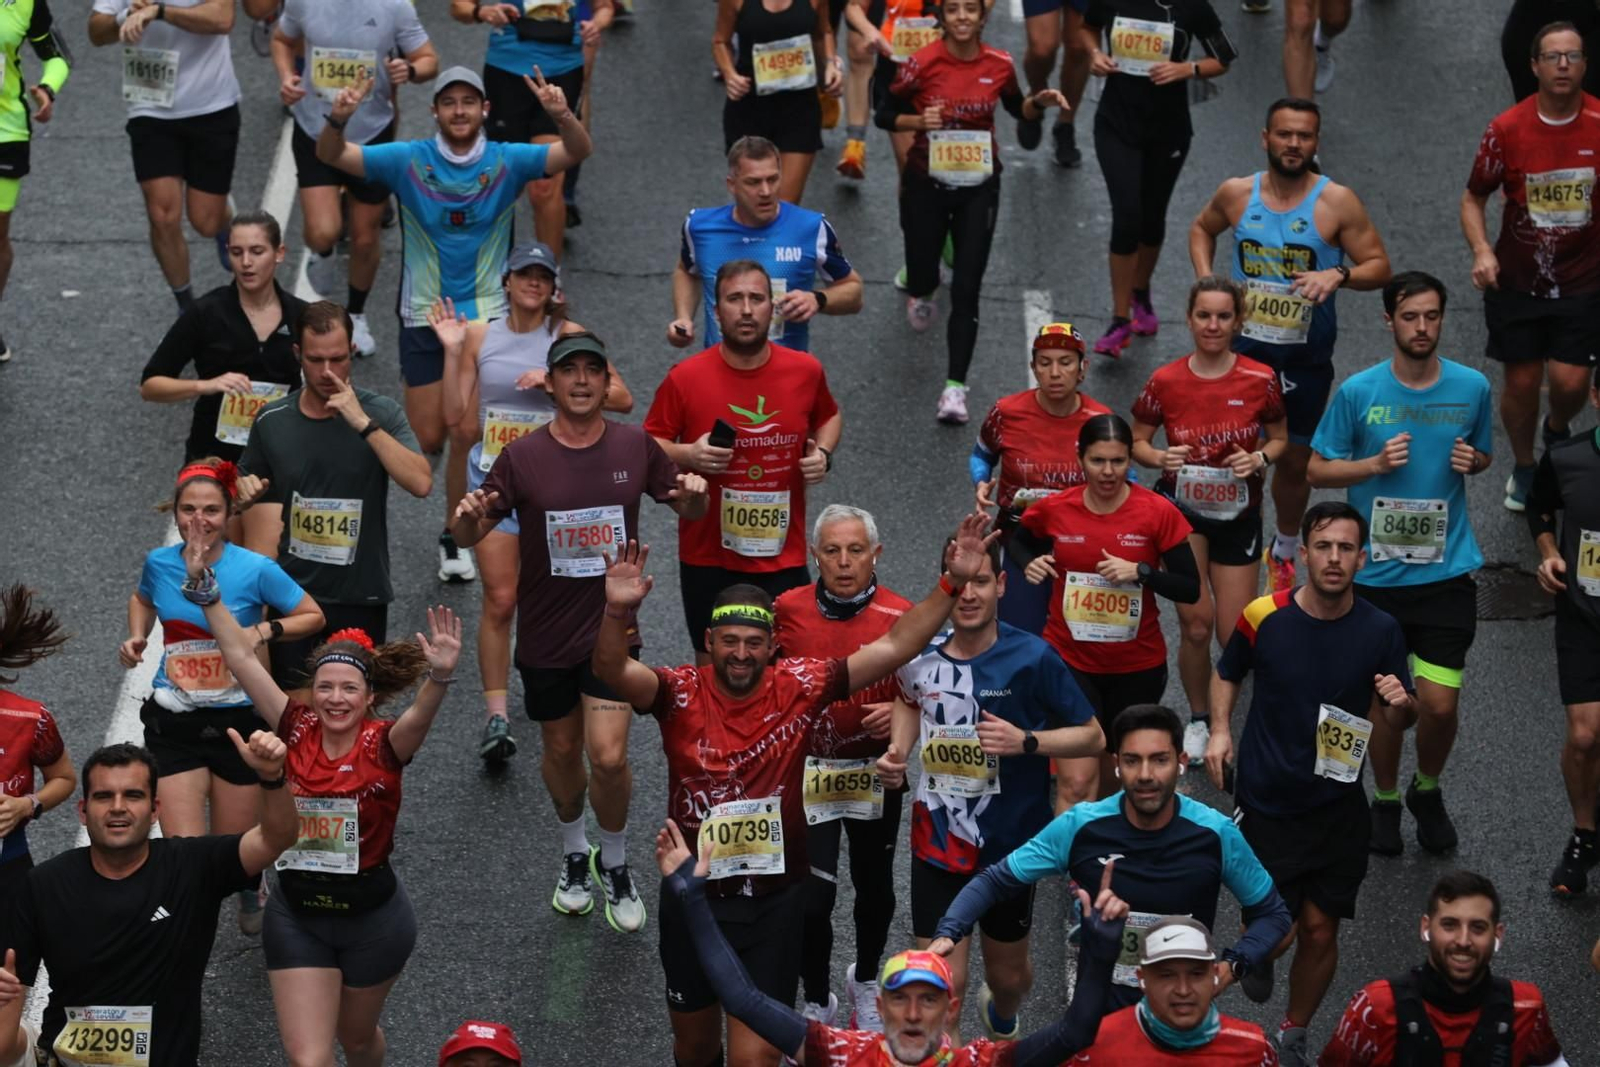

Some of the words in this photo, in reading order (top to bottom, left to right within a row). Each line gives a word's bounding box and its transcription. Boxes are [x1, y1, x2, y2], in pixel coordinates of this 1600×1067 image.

[1117, 32, 1163, 53] 10718
[936, 145, 982, 163] 11333
[1533, 183, 1585, 203] 14675
[1249, 294, 1302, 319] 14007
[1366, 405, 1470, 427] RUNNING
[1183, 481, 1237, 502] 16289
[293, 511, 349, 536] 14814
[727, 505, 780, 528] 10658
[1383, 514, 1431, 536] 8436
[554, 524, 613, 549] 17580
[1071, 590, 1130, 615] 14509
[174, 656, 222, 680] 3857
[980, 688, 1012, 698] GRANADA
[925, 744, 985, 766] 10689
[811, 773, 871, 793] 11659
[705, 819, 770, 845] 10739
[68, 1027, 134, 1052] 13299
